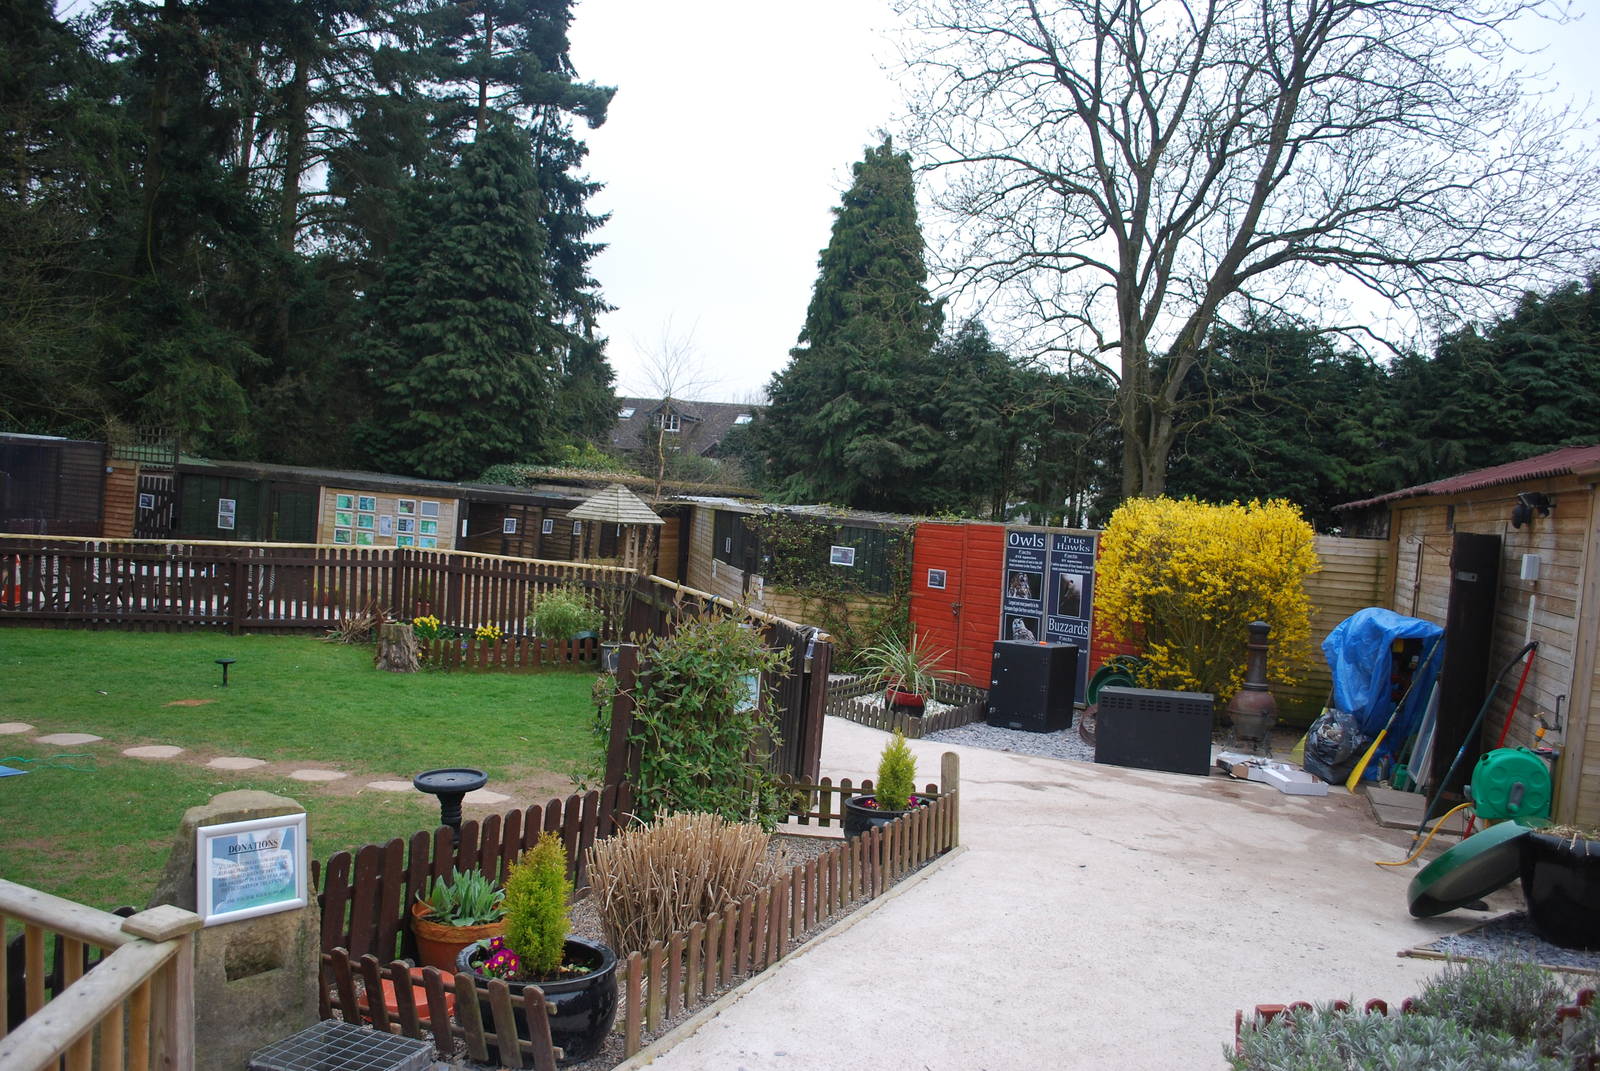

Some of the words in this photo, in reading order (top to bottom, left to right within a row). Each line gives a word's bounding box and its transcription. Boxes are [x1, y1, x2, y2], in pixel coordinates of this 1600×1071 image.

[1009, 532, 1044, 548] Owls
[1057, 542, 1090, 552] Hawks
[1062, 535, 1086, 544] True
[1048, 617, 1088, 636] Buzzards
[228, 839, 279, 854] DONATIONS
